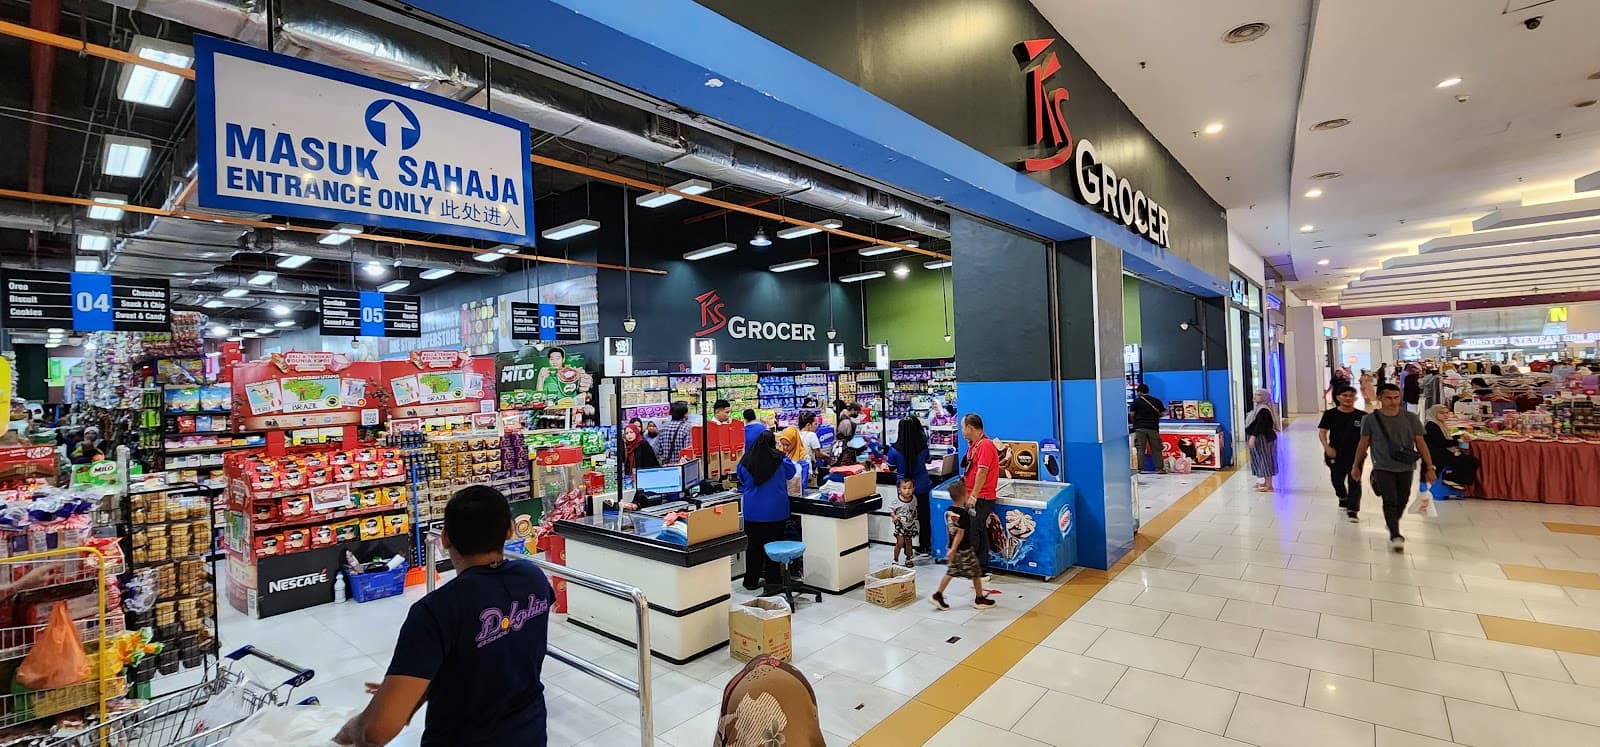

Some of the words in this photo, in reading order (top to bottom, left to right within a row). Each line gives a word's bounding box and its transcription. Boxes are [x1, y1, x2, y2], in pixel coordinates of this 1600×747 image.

[225, 122, 379, 180] MASUK
[399, 155, 519, 206] SAHAJA
[226, 166, 372, 207] ENTRANCE
[378, 189, 433, 214] ONLY
[1075, 139, 1170, 248] GROCER
[440, 199, 520, 229] 此处进入
[9, 295, 38, 304] Biscuit
[131, 289, 165, 298] Chocolate
[76, 292, 110, 313] 04
[10, 308, 42, 316] Cookies
[145, 312, 166, 322] Candy
[362, 307, 383, 323] 05
[540, 315, 555, 329] 06
[727, 315, 816, 342] GROCER
[619, 358, 627, 374] 1
[703, 357, 711, 370] 2
[501, 368, 535, 383] MILO
[291, 402, 318, 411] BRAZIL
[94, 465, 114, 474] MILO
